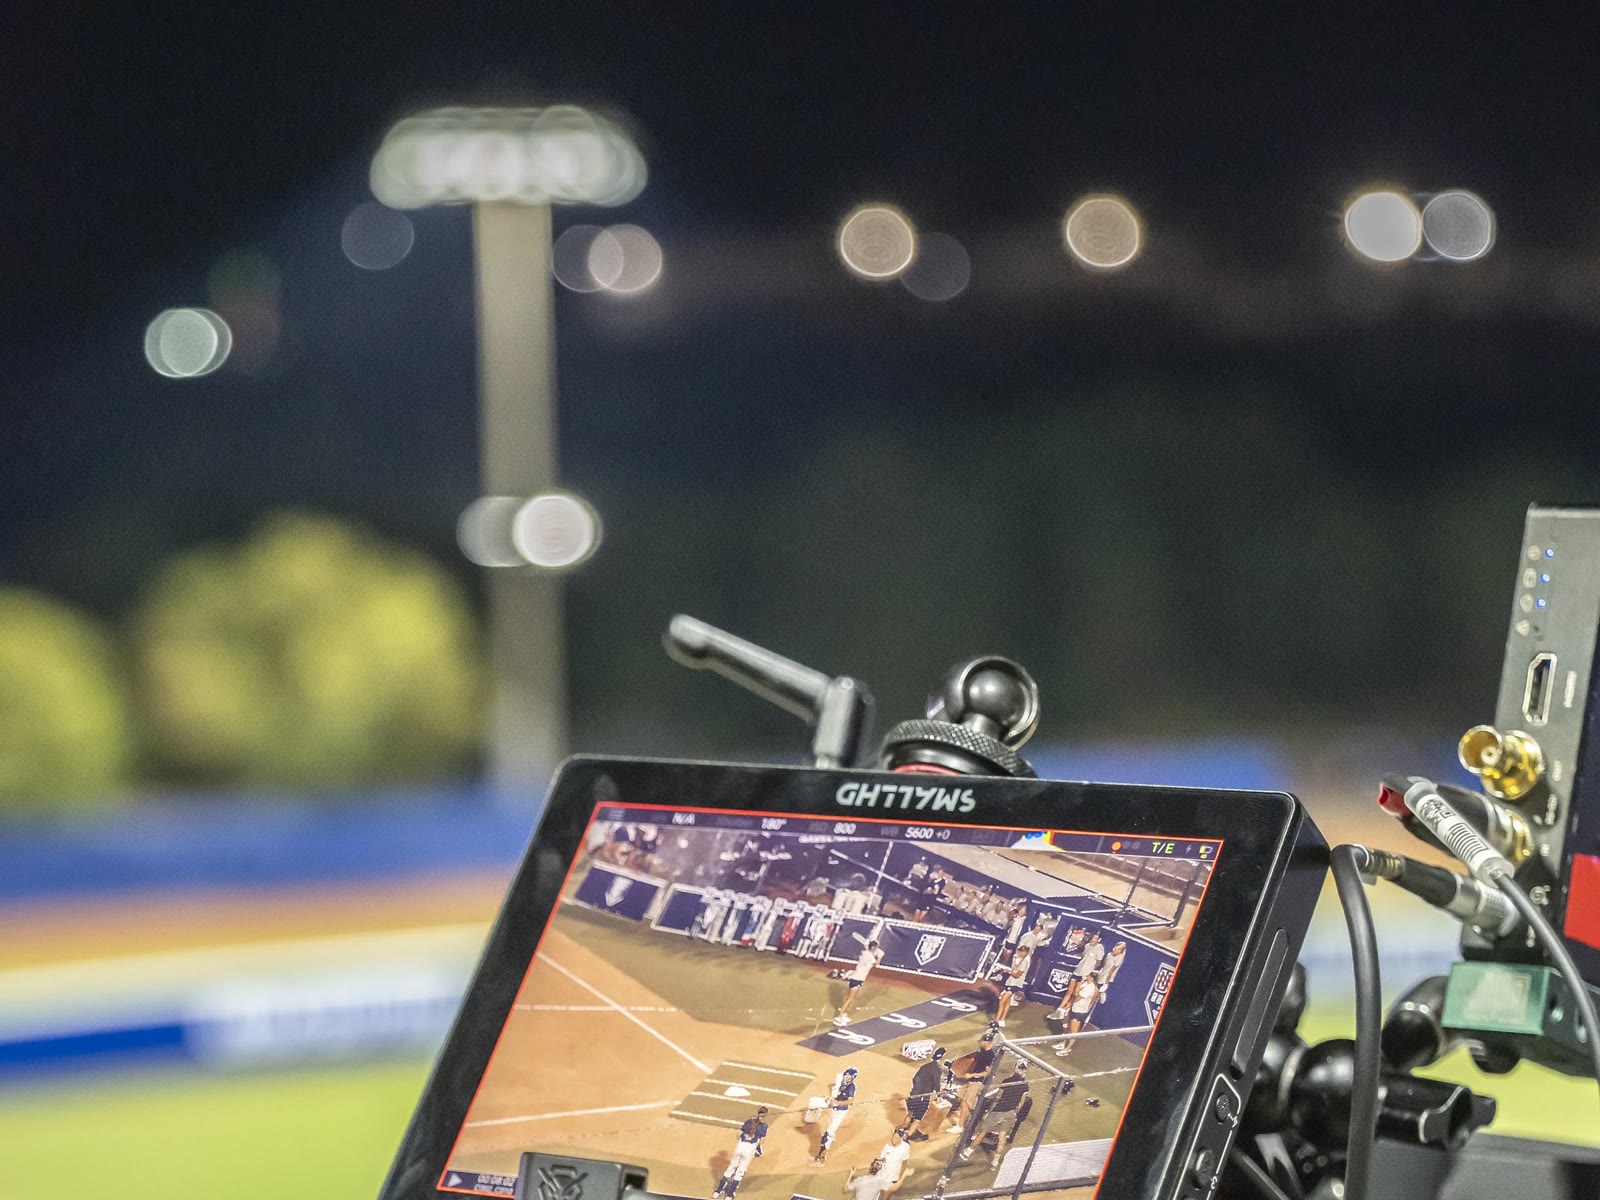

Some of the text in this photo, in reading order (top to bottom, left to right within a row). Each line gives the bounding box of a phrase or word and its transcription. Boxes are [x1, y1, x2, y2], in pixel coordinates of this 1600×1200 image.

[672, 812, 696, 825] N/A
[833, 822, 857, 835] 800
[905, 826, 934, 840] 5600
[935, 829, 951, 841] +0
[1152, 842, 1175, 854] T/E
